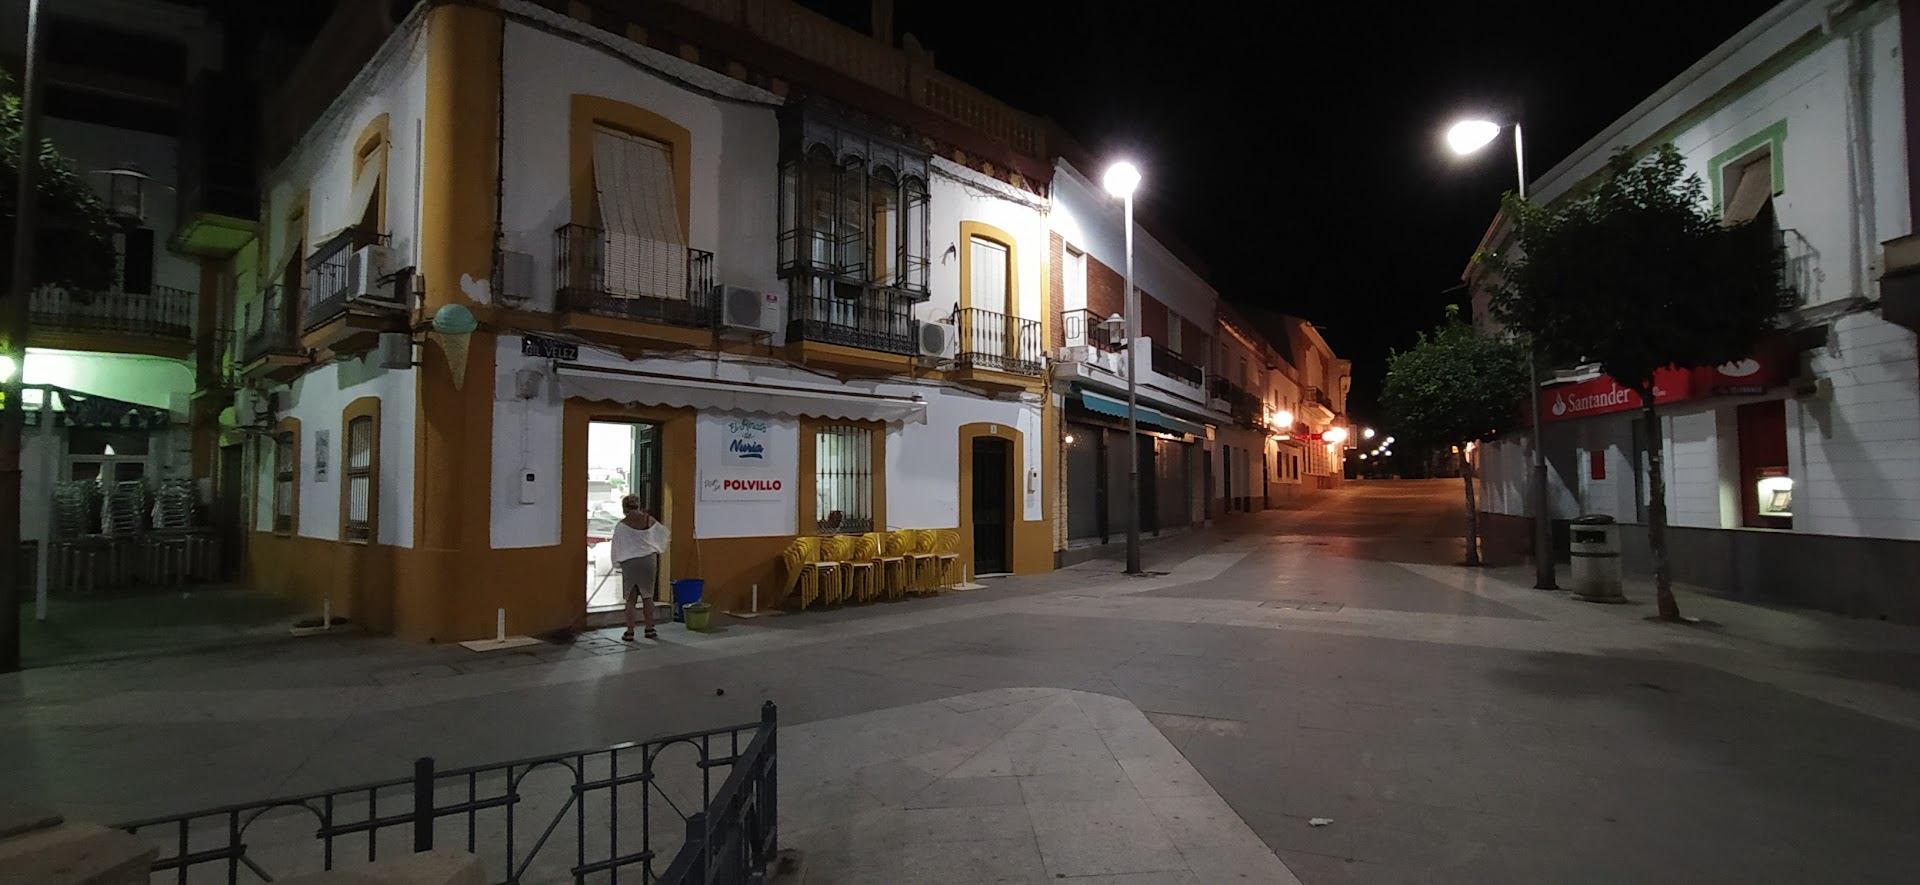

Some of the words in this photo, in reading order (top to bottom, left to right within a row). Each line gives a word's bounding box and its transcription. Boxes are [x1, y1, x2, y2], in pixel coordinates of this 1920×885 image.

[525, 344, 541, 356] GIL
[545, 346, 576, 359] VELEZ
[1567, 382, 1631, 413] Santander
[728, 422, 738, 434] El
[729, 439, 764, 453] Nuria
[723, 479, 782, 491] POLVILLO
